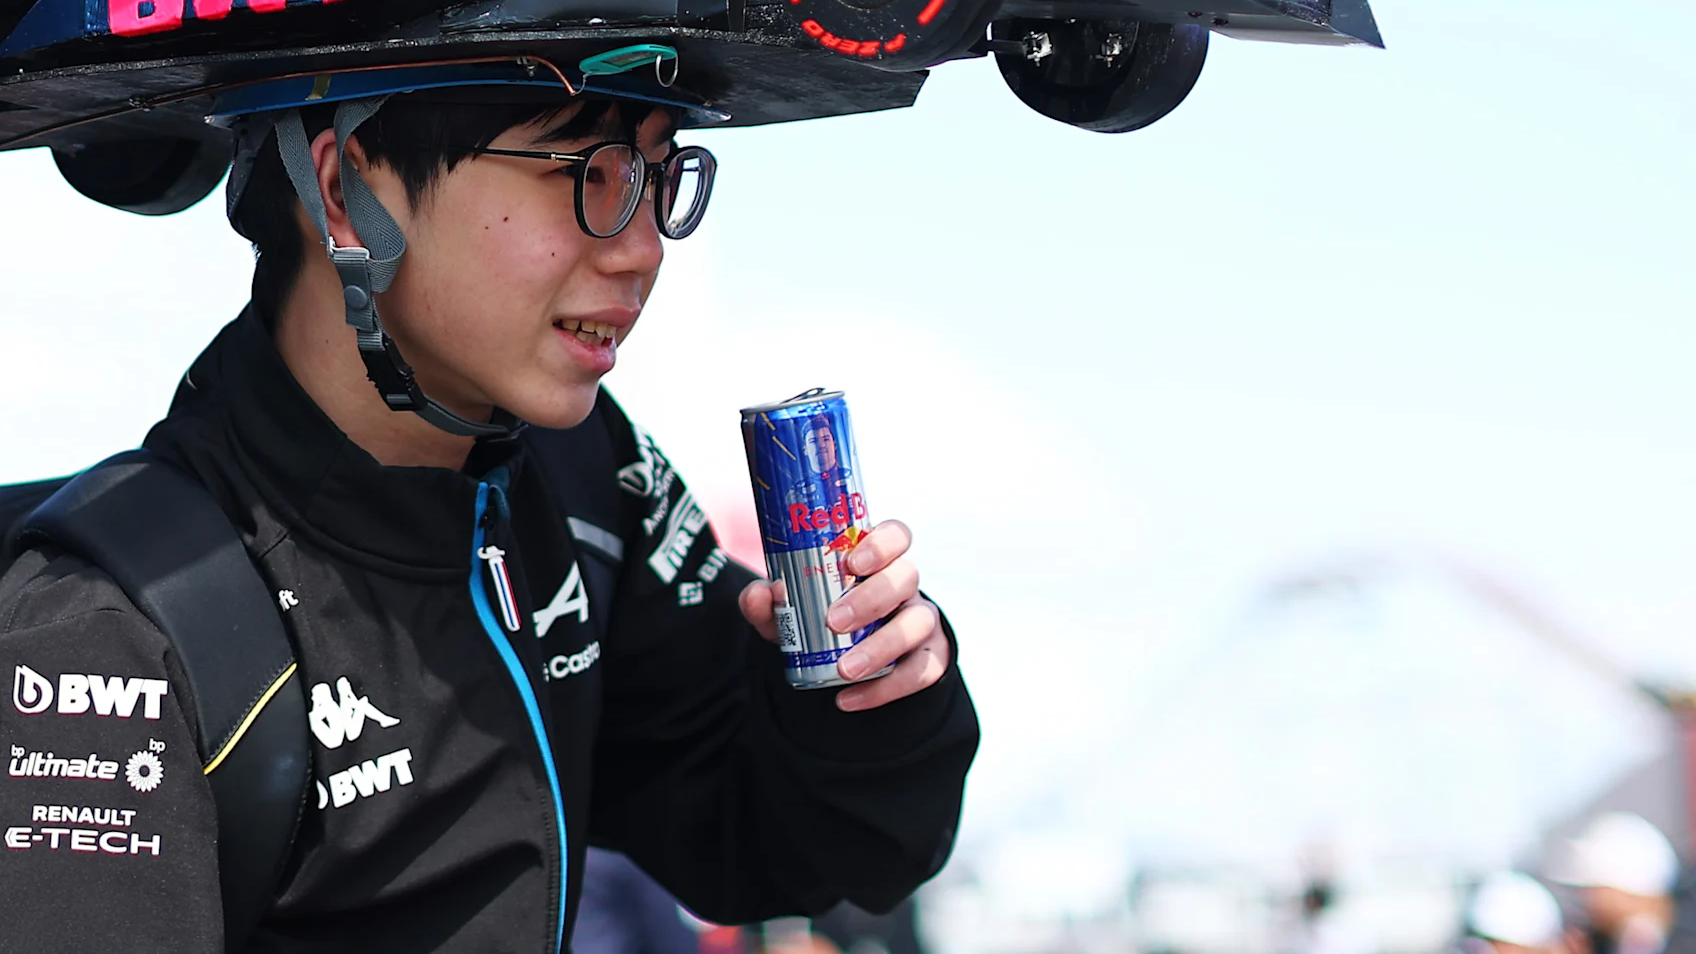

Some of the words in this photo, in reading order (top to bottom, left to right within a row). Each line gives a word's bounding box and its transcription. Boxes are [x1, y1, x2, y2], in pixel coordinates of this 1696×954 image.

[788, 493, 851, 534] Red
[647, 489, 708, 584] PIRE
[57, 673, 169, 721] BWT
[11, 744, 26, 759] bp
[149, 738, 166, 754] bp
[8, 751, 120, 781] ultimate
[329, 748, 414, 809] BWT
[32, 804, 137, 827] RENAULT
[4, 826, 162, 857] E-TECH
